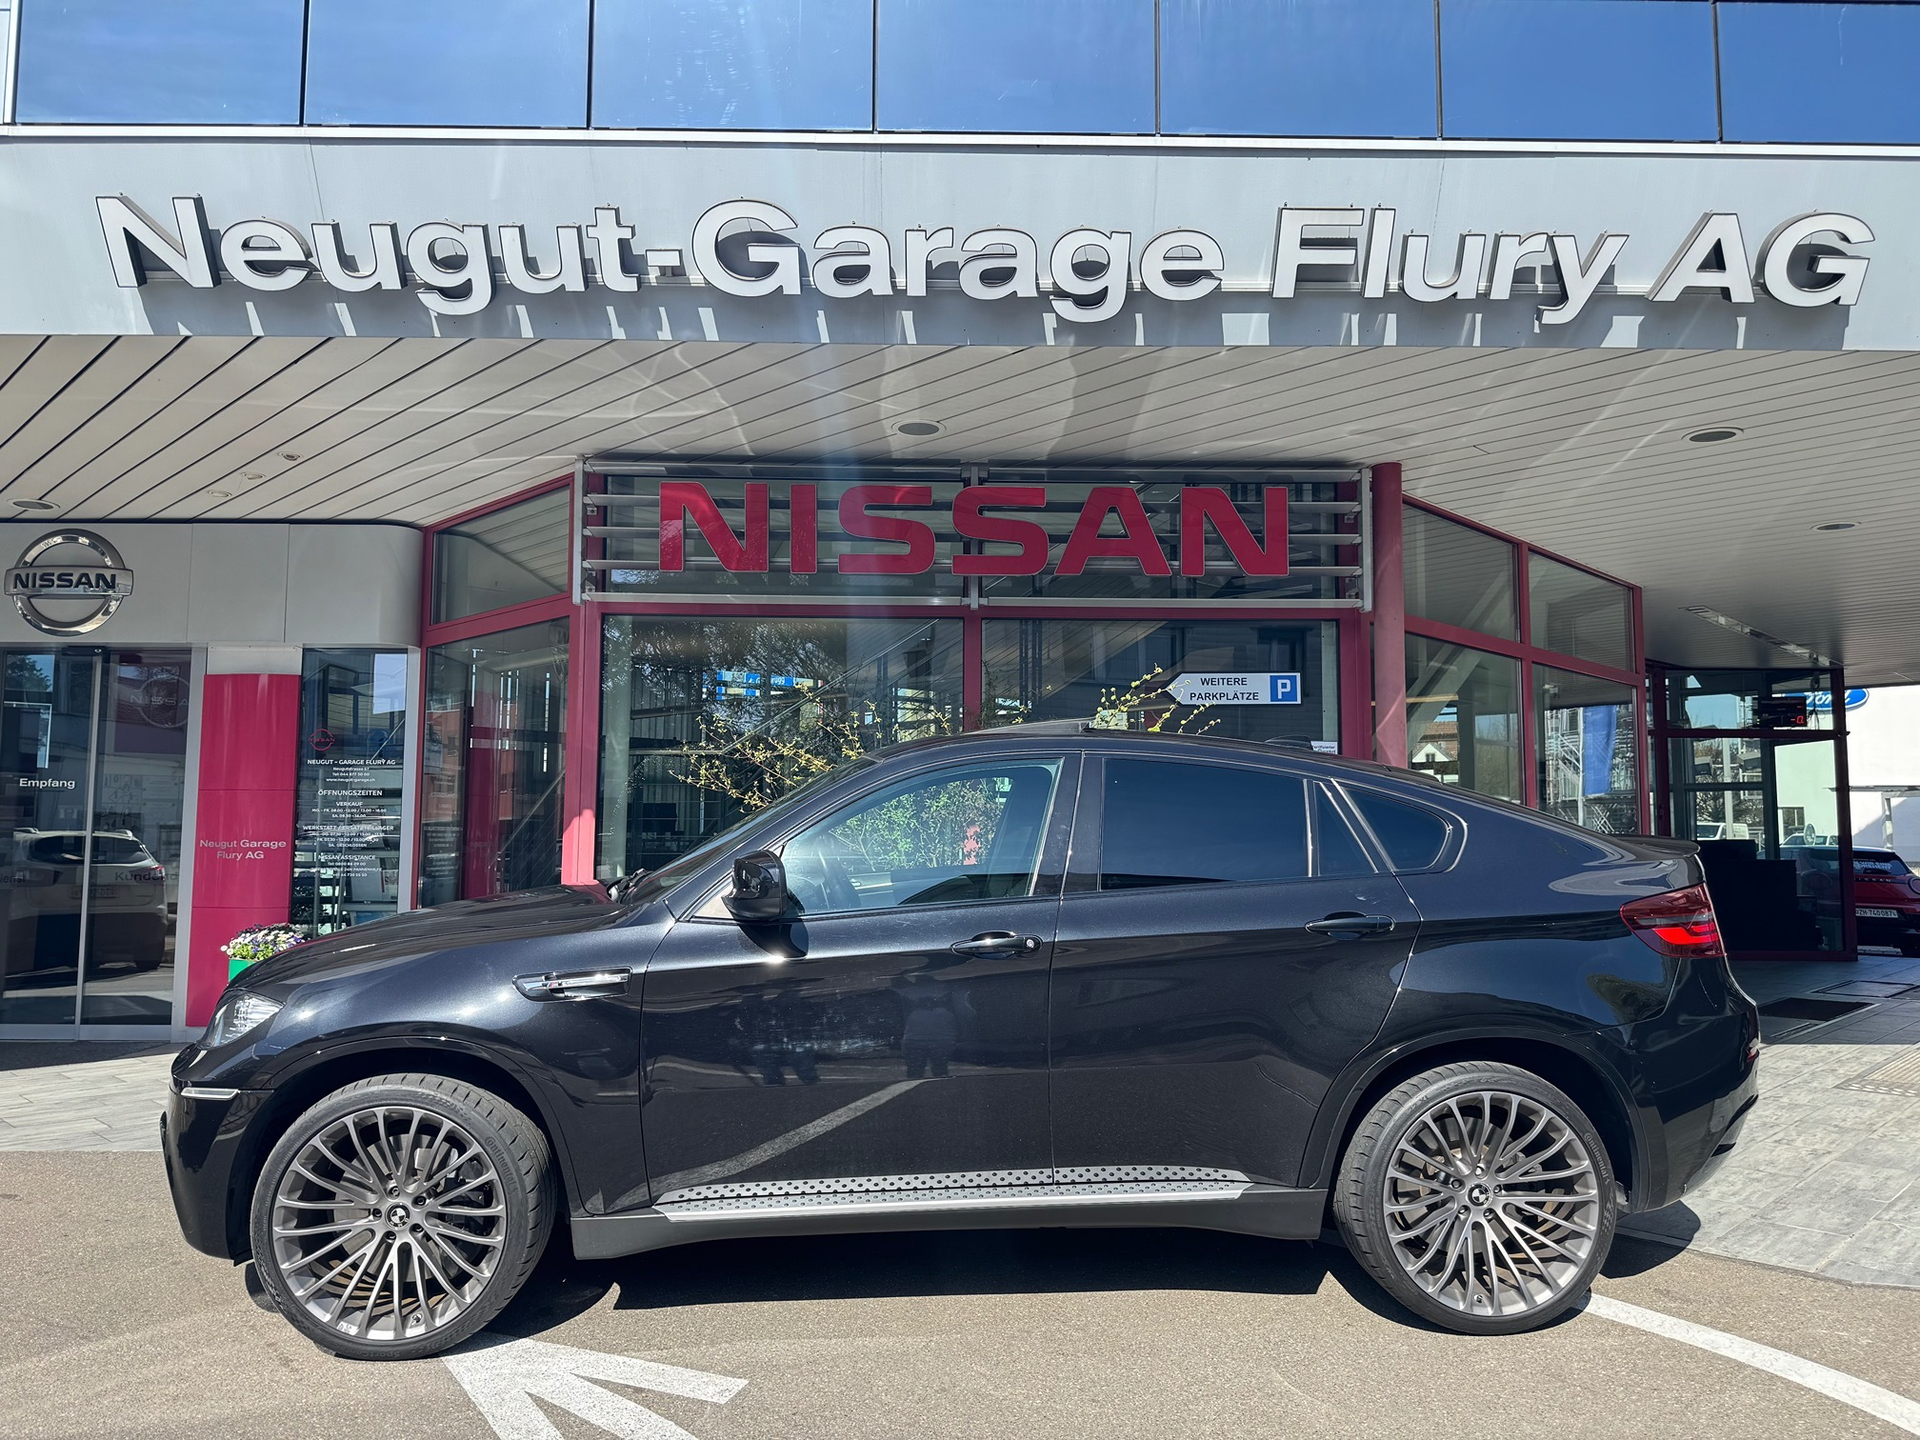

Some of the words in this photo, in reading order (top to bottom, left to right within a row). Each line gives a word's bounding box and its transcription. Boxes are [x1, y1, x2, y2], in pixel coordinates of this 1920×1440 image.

[96, 196, 1223, 324] Neugut-Garage
[1271, 207, 1628, 326] Flury
[1645, 210, 1876, 308] AG
[658, 481, 1290, 578] NISSAN
[13, 572, 117, 589] NISSAN
[1200, 677, 1248, 686] WEITERE
[1190, 690, 1259, 701] PARKPLÄTZE
[19, 778, 76, 790] Empfang
[200, 839, 237, 849] Neugut
[240, 839, 286, 849] Garage
[216, 851, 243, 861] Flury
[245, 851, 264, 859] AG
[485, 1136, 517, 1186] Continental
[1584, 1132, 1609, 1179] Continental
